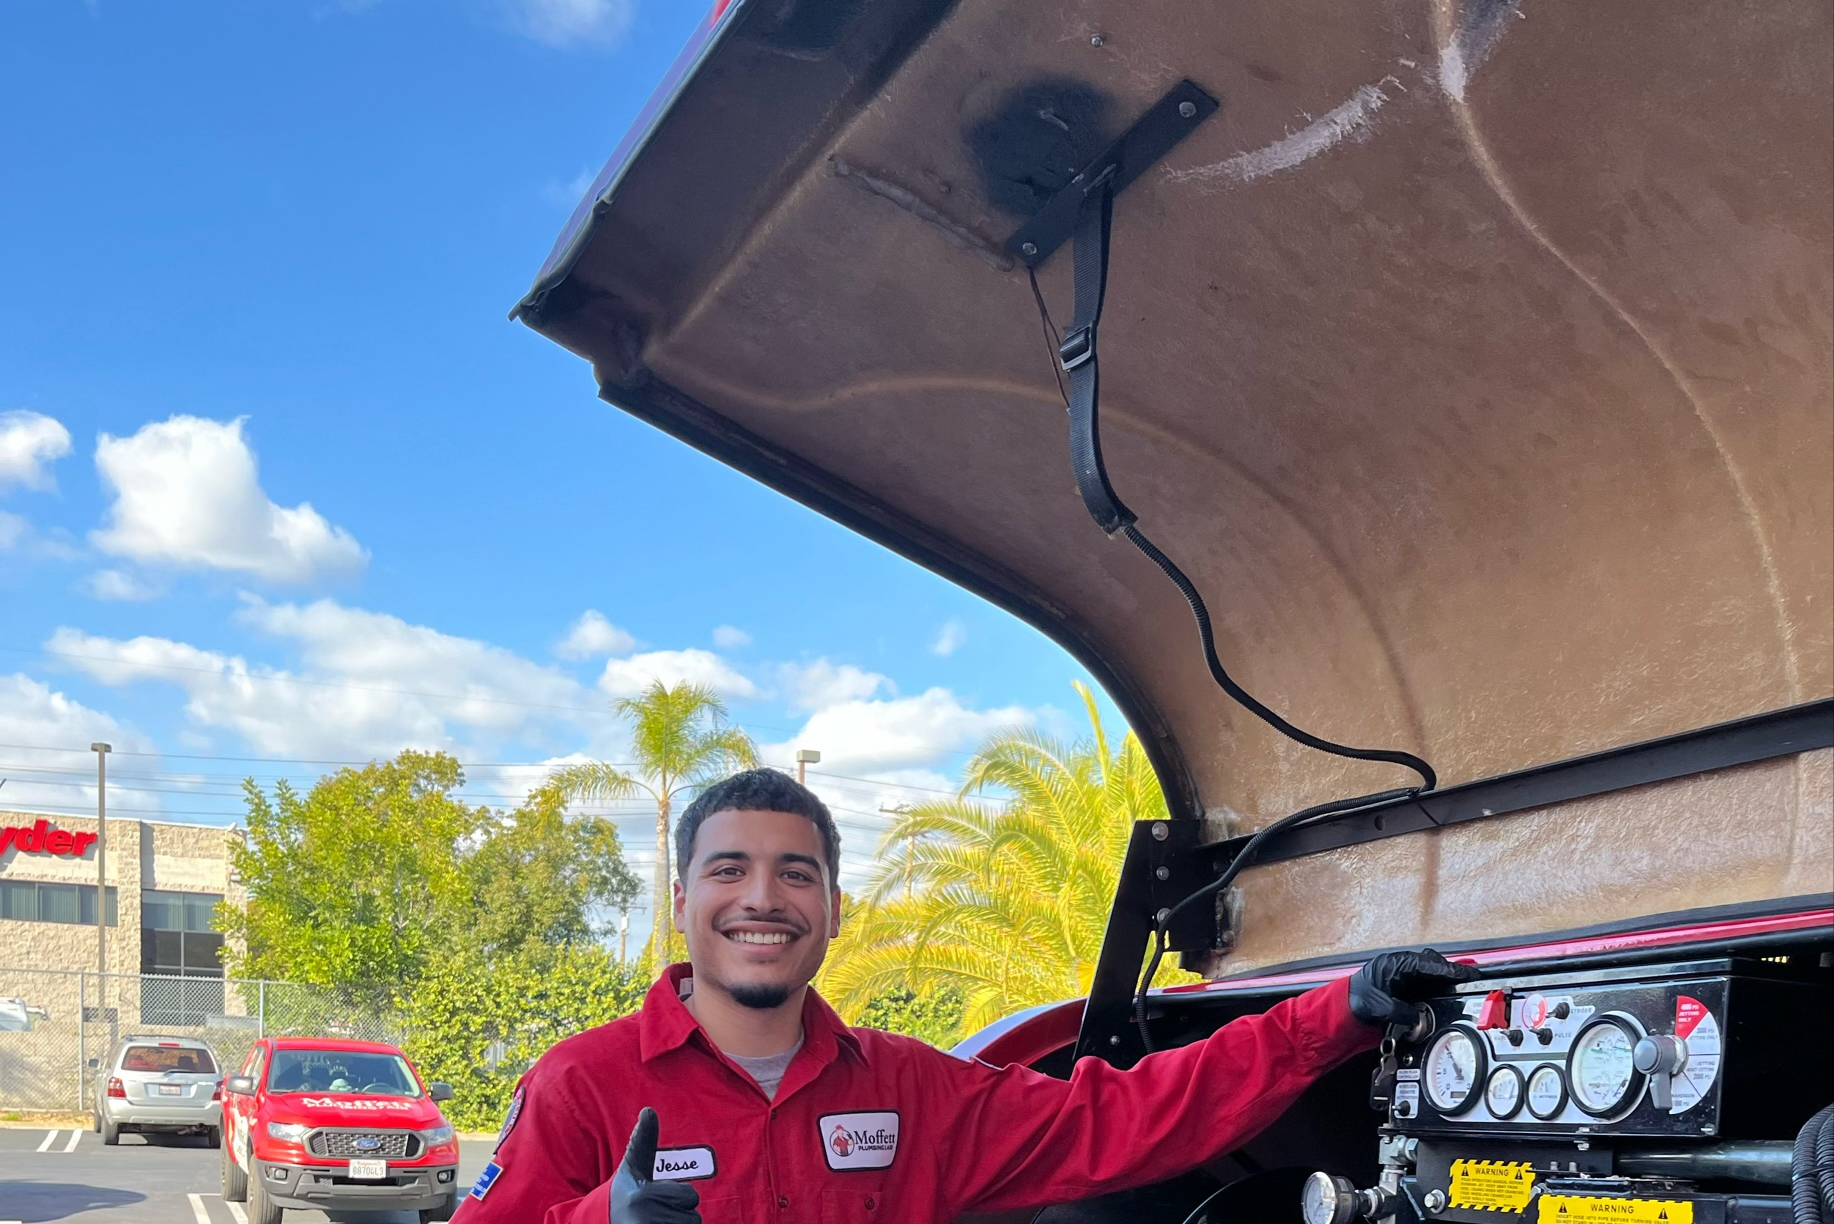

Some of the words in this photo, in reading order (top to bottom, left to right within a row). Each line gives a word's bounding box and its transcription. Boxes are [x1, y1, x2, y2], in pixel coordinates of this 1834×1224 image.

[0, 819, 98, 856] yder
[853, 1128, 896, 1145] Moffett
[656, 1158, 699, 1173] Jesse
[1475, 1168, 1509, 1176] WARNING
[1591, 1204, 1634, 1214] WARNING
